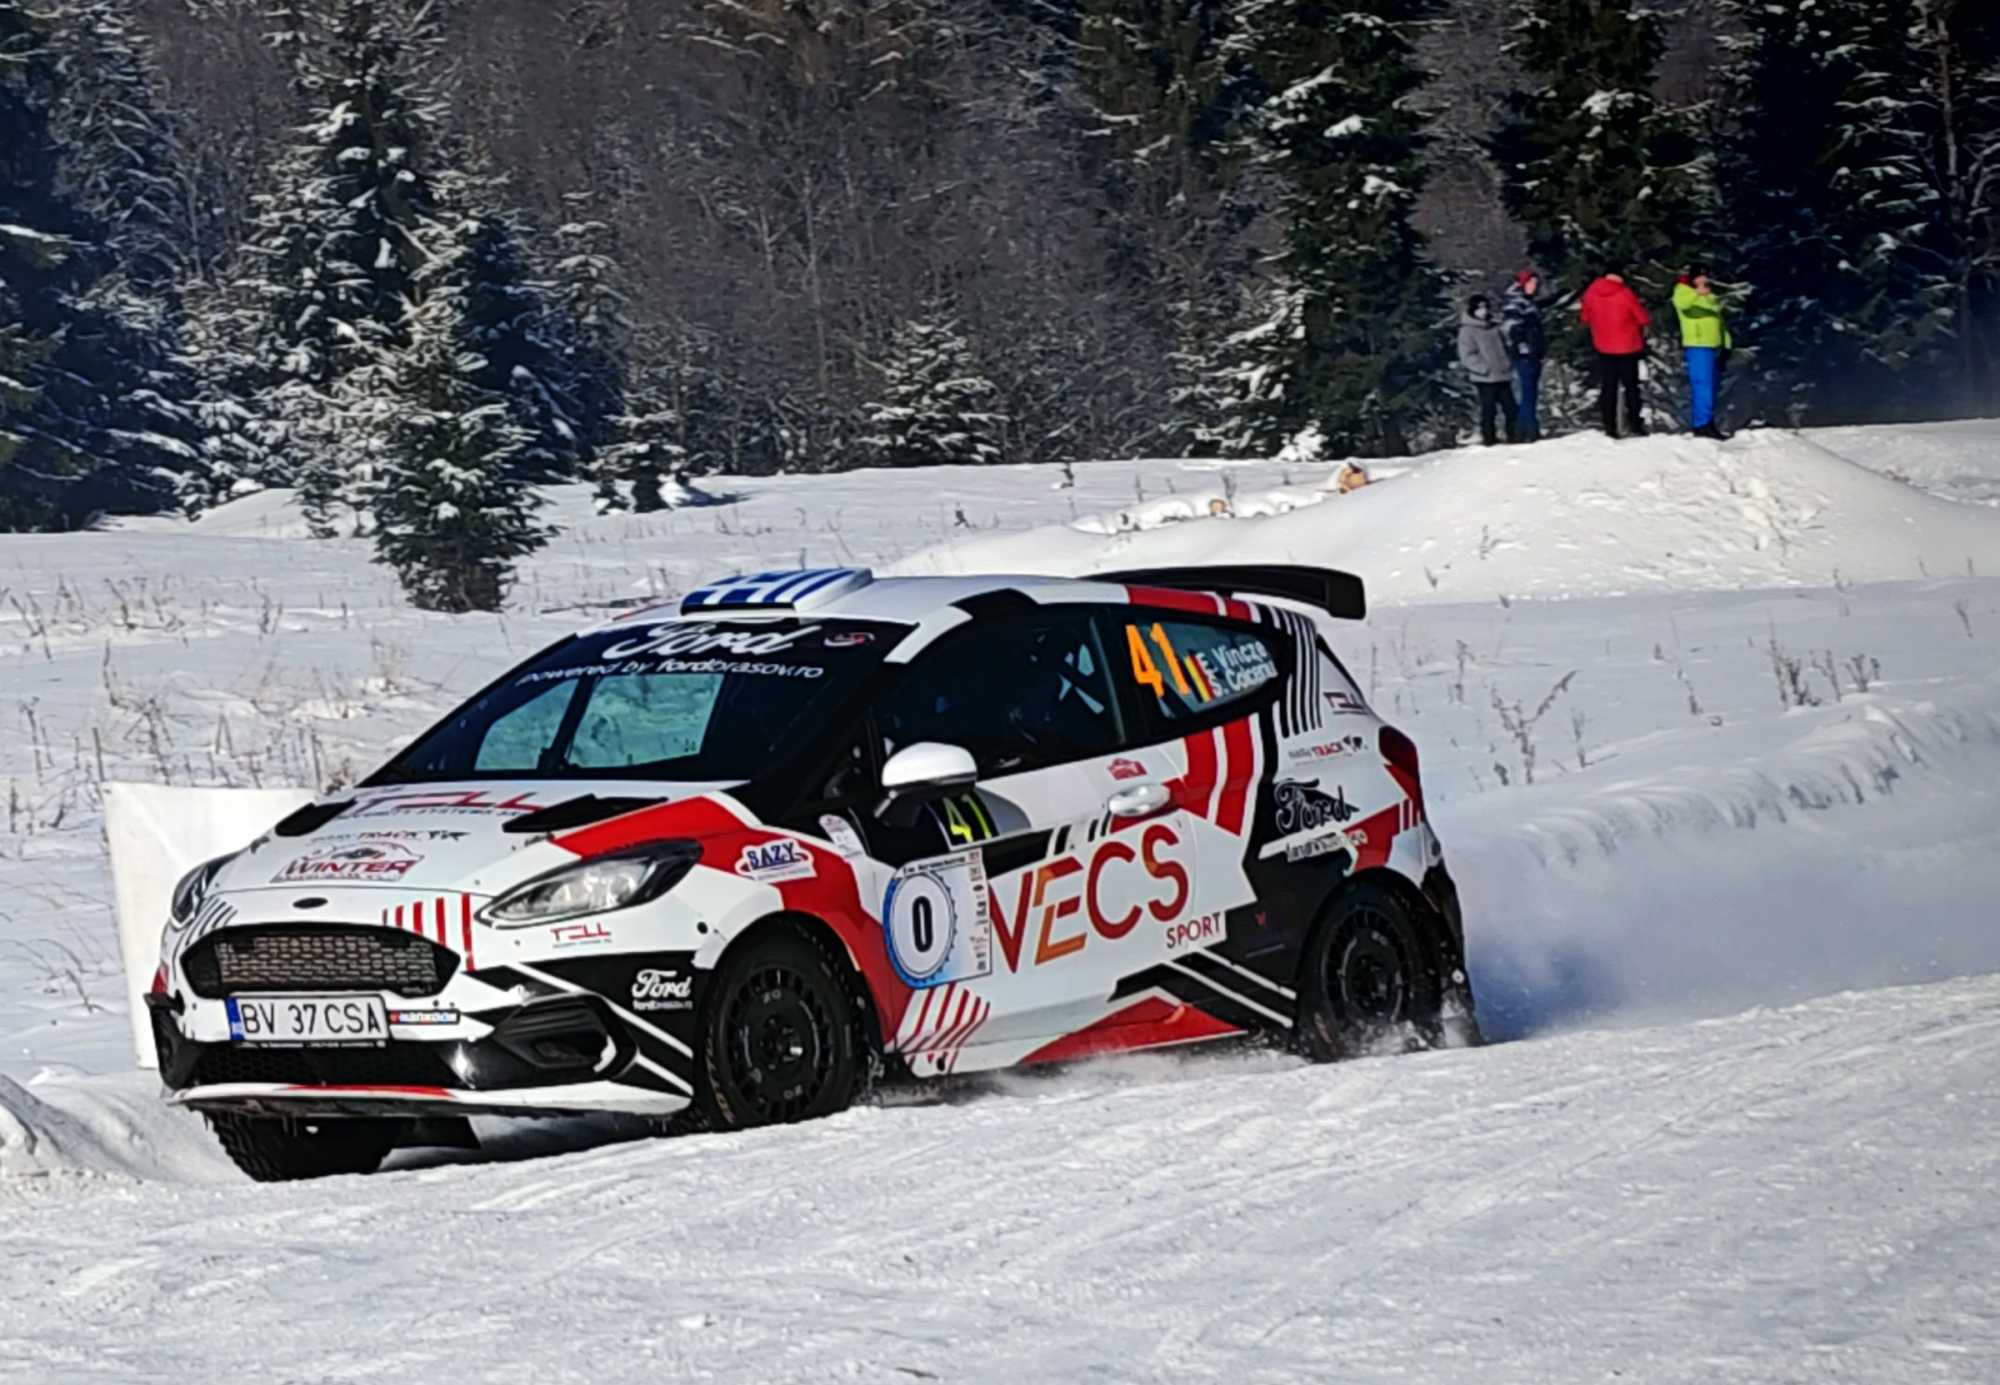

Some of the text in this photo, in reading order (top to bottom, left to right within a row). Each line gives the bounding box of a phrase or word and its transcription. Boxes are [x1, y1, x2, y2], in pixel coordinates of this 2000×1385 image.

[602, 621, 822, 659] Ford
[620, 660, 655, 675] by
[656, 658, 824, 679] fordbrasov.ro
[1125, 623, 1190, 699] 41
[1273, 777, 1360, 835] Ford
[286, 858, 417, 875] WINTER
[911, 895, 934, 954] 0
[1166, 911, 1222, 949] SPORT
[631, 968, 692, 999] Ford
[241, 1003, 275, 1034] BV
[288, 1003, 317, 1034] 37
[324, 1002, 383, 1034] CSA
